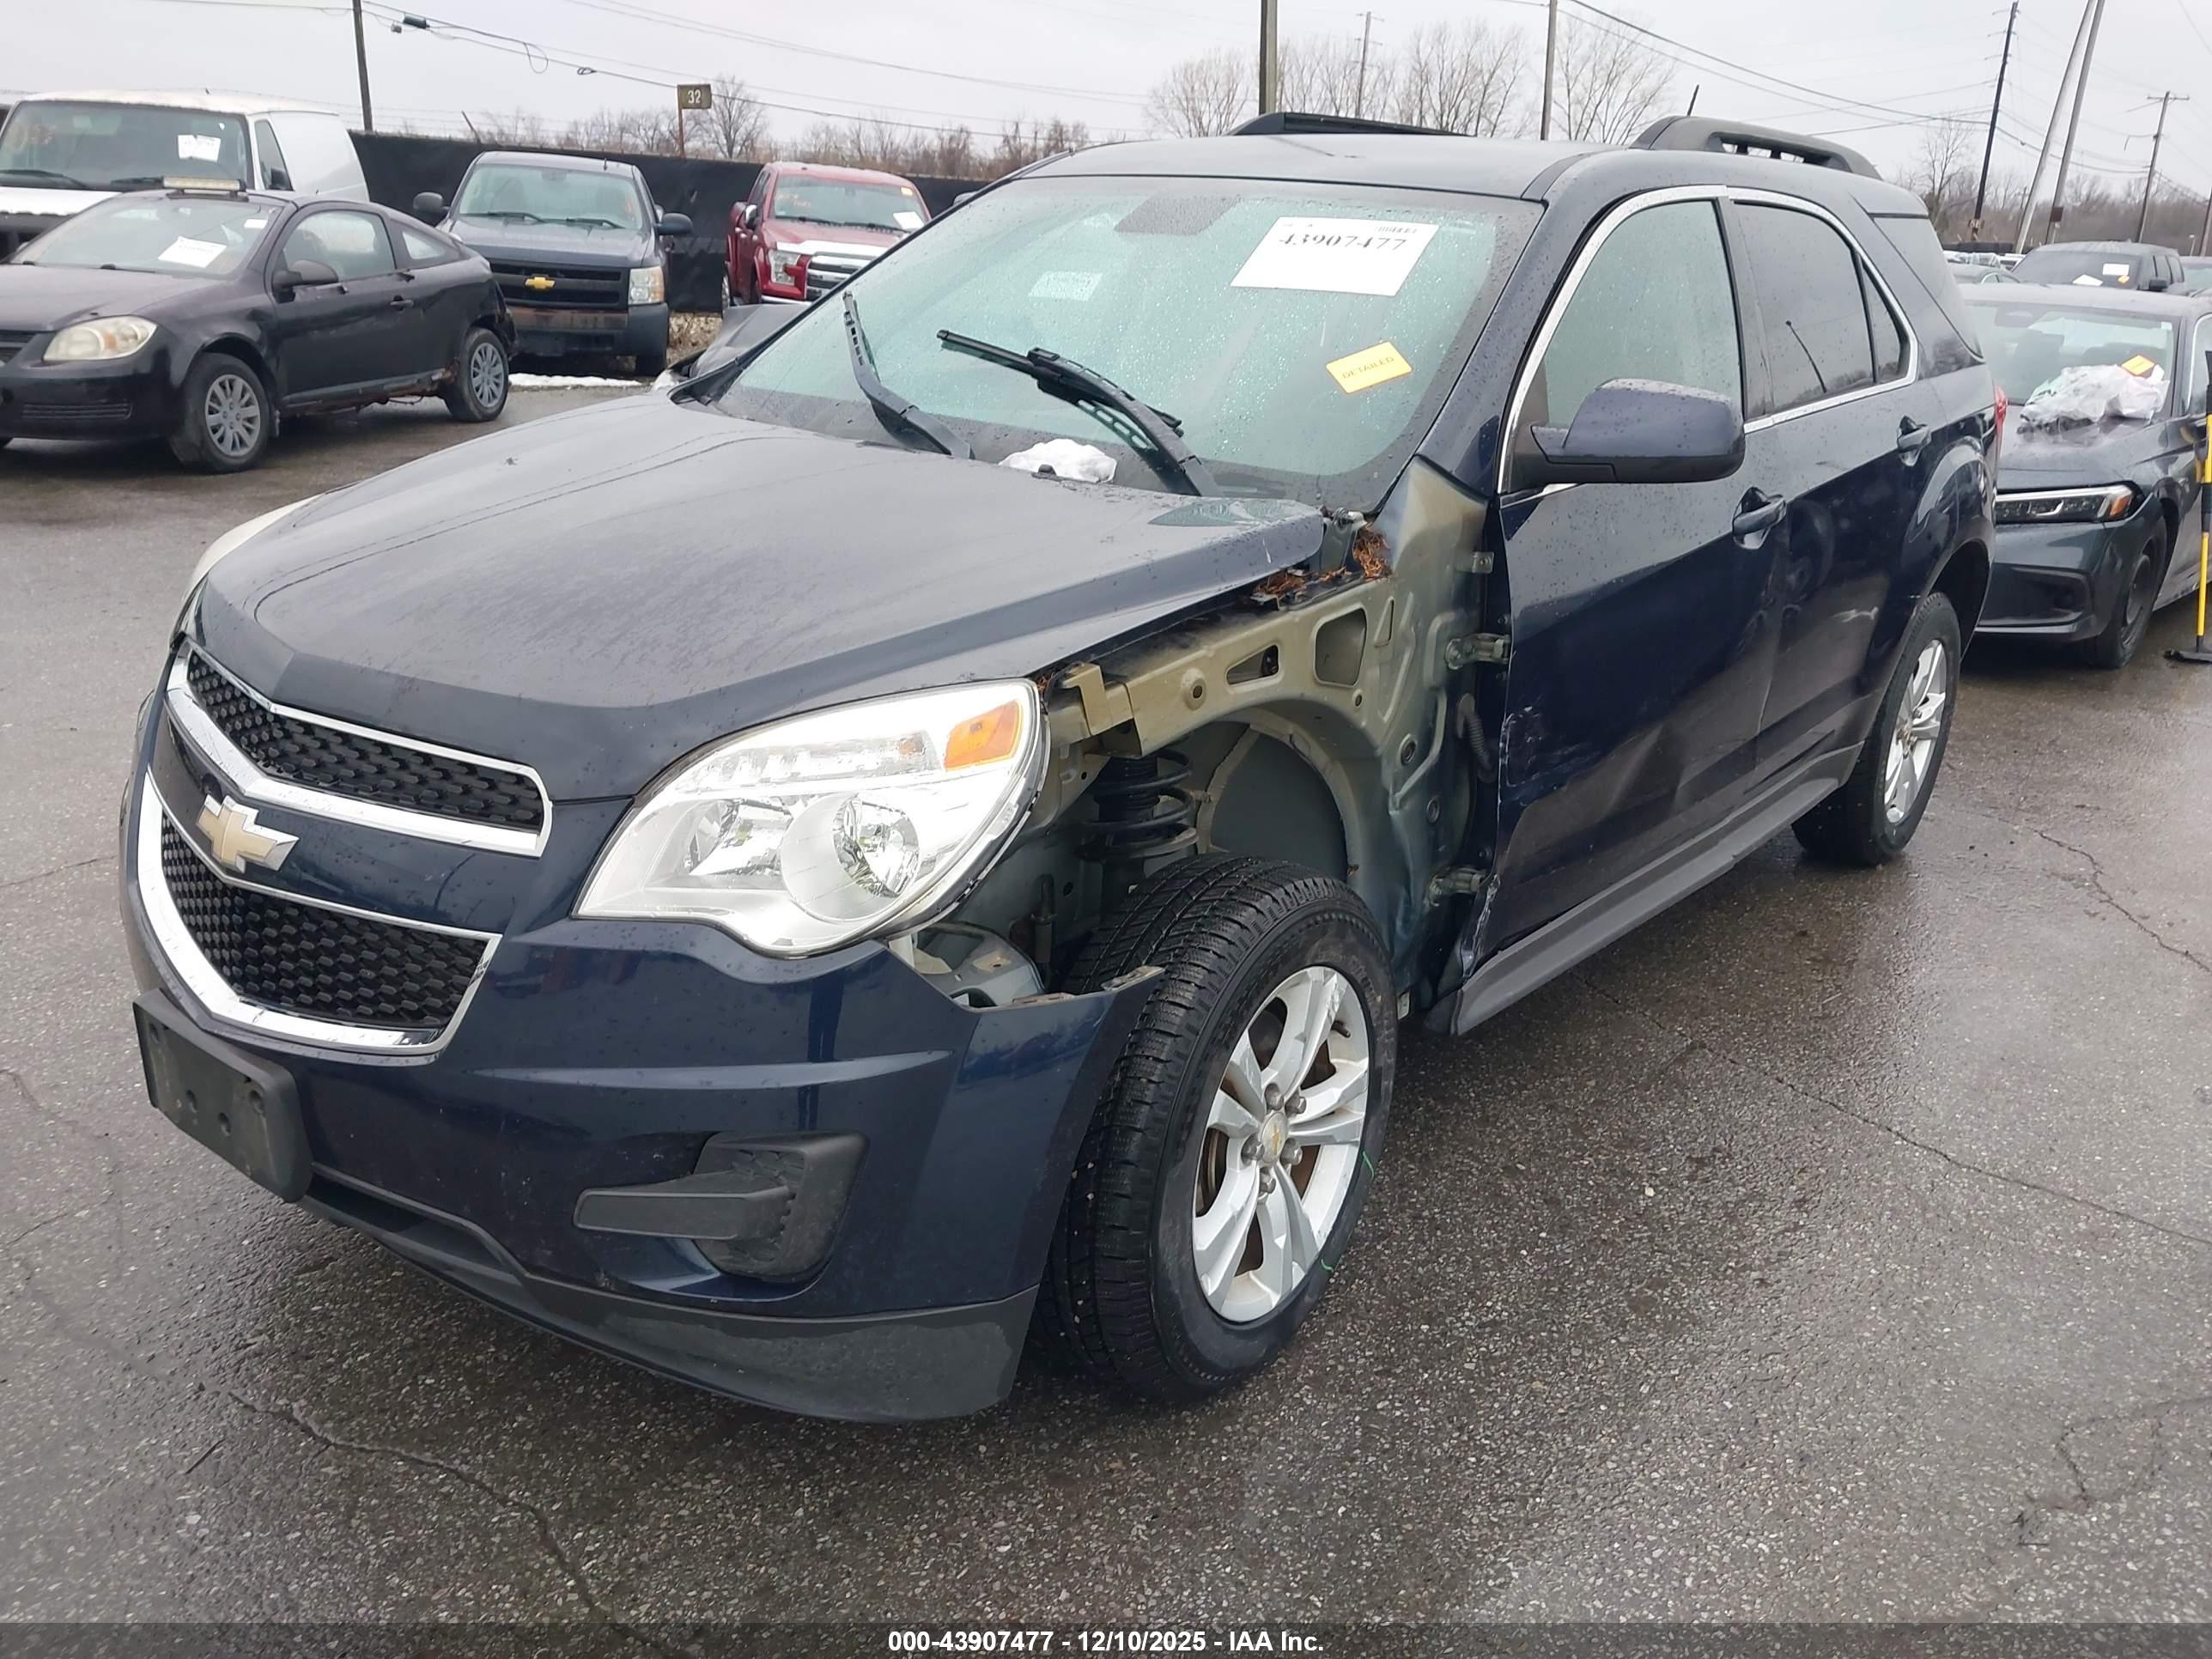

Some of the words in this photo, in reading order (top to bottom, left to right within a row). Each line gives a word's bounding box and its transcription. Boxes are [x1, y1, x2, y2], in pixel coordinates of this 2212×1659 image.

[688, 89, 701, 103] 32
[1279, 233, 1407, 251] 43907477
[1342, 356, 1395, 379] DETAILED
